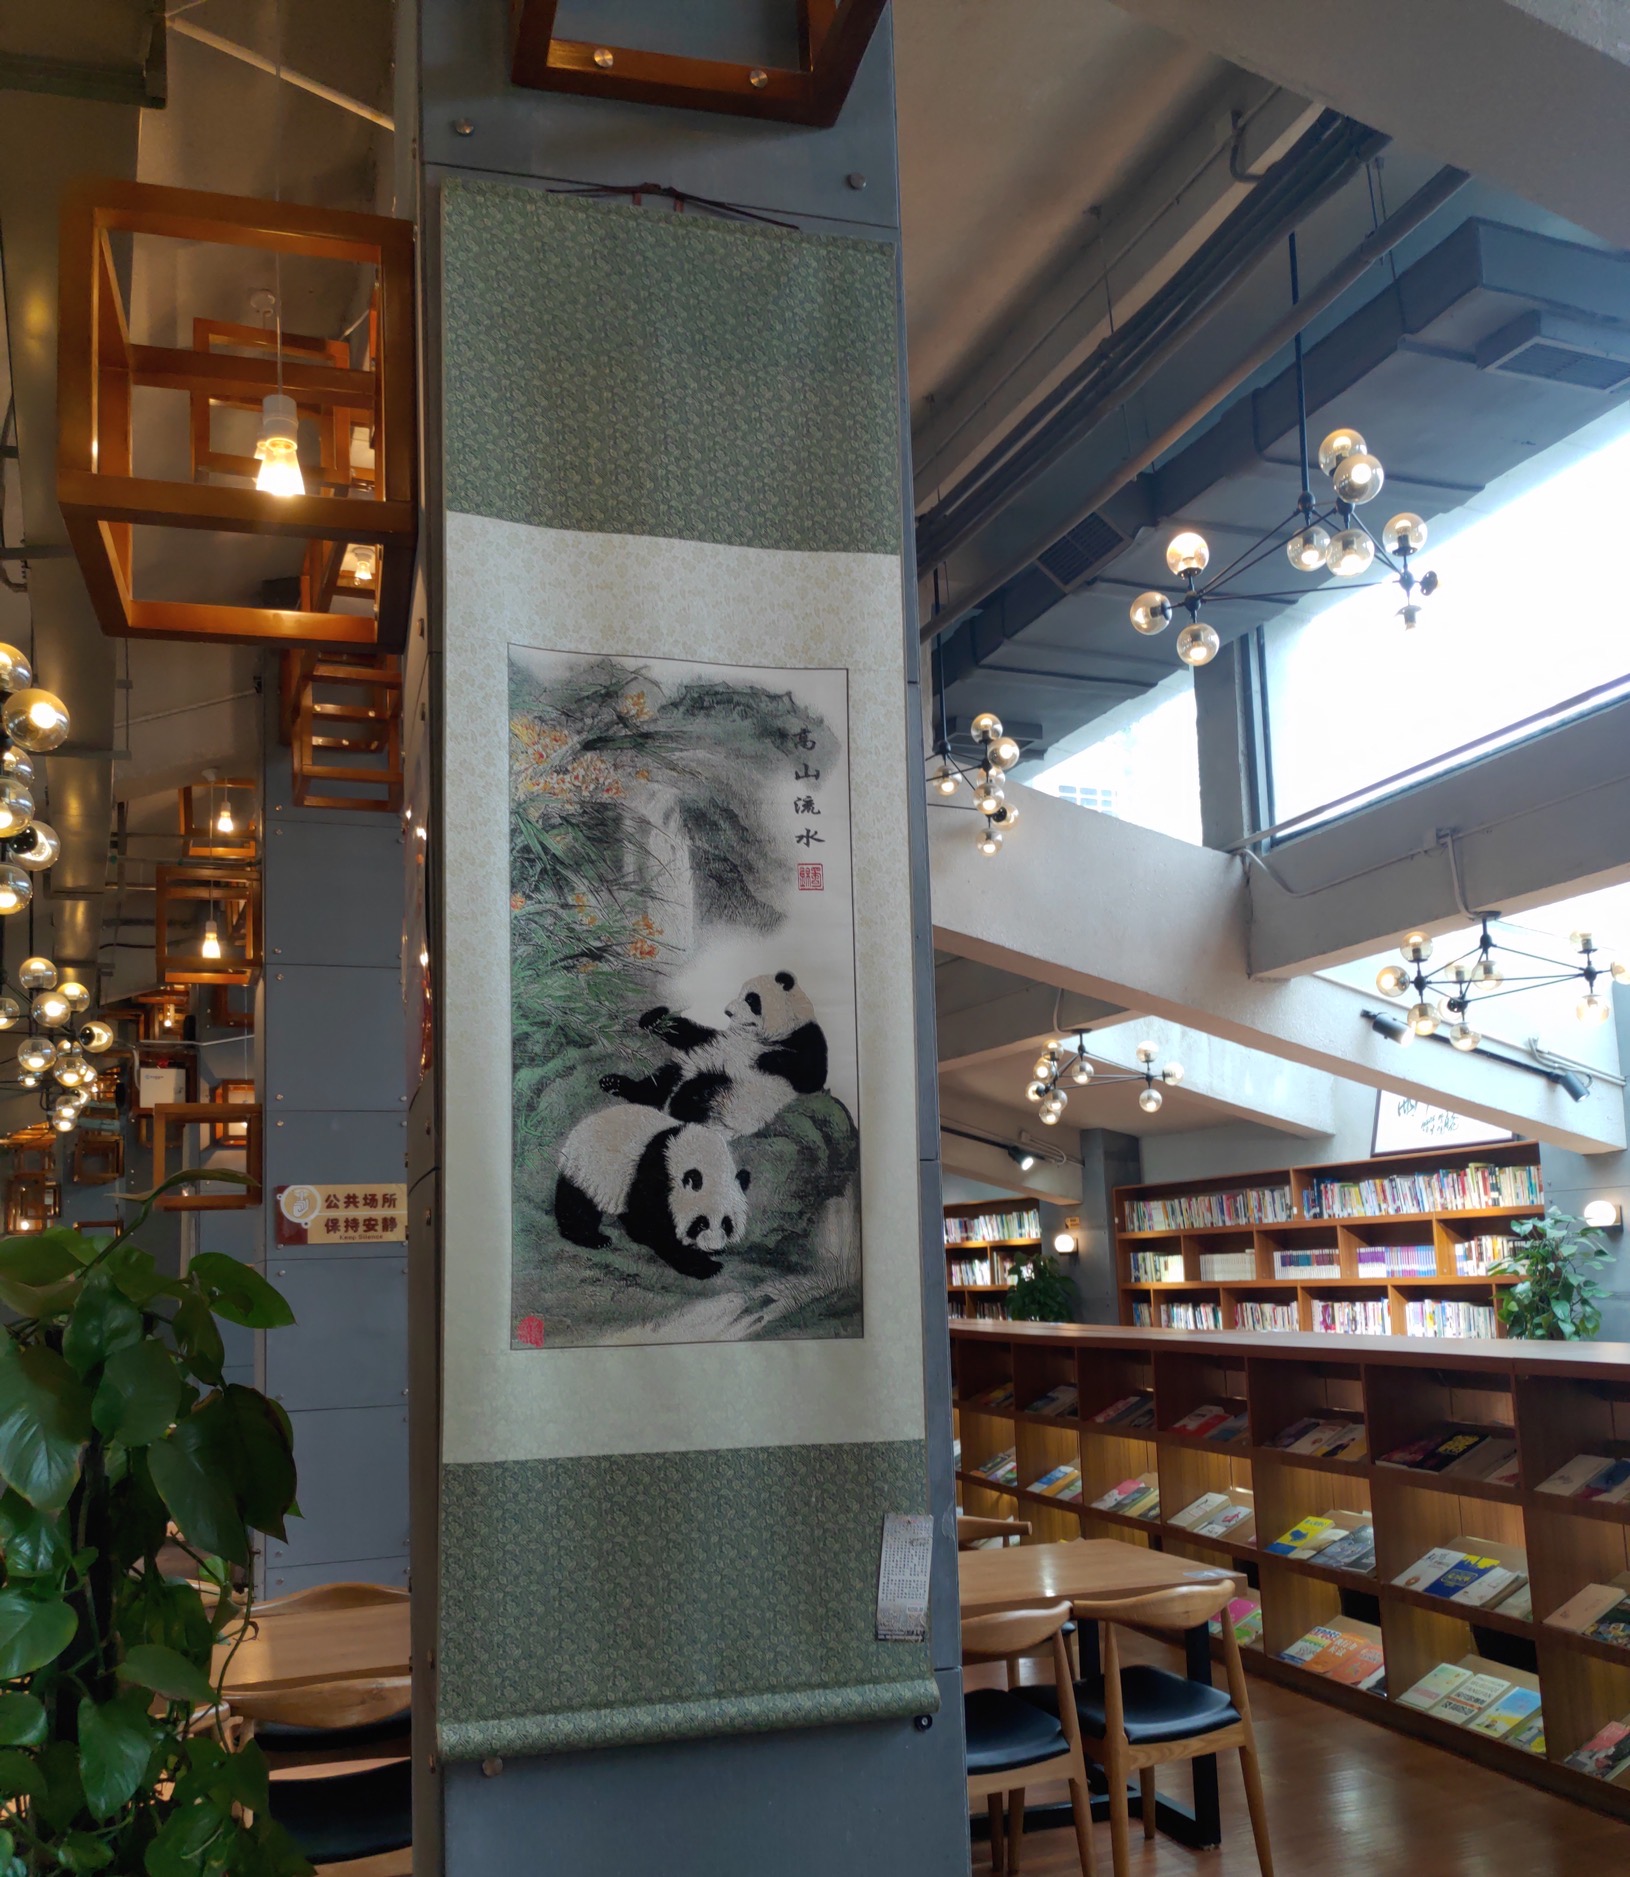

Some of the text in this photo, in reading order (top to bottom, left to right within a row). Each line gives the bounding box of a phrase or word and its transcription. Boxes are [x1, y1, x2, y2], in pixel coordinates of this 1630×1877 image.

[324, 1193, 398, 1210] 公共场所
[324, 1216, 398, 1234] 保持安静
